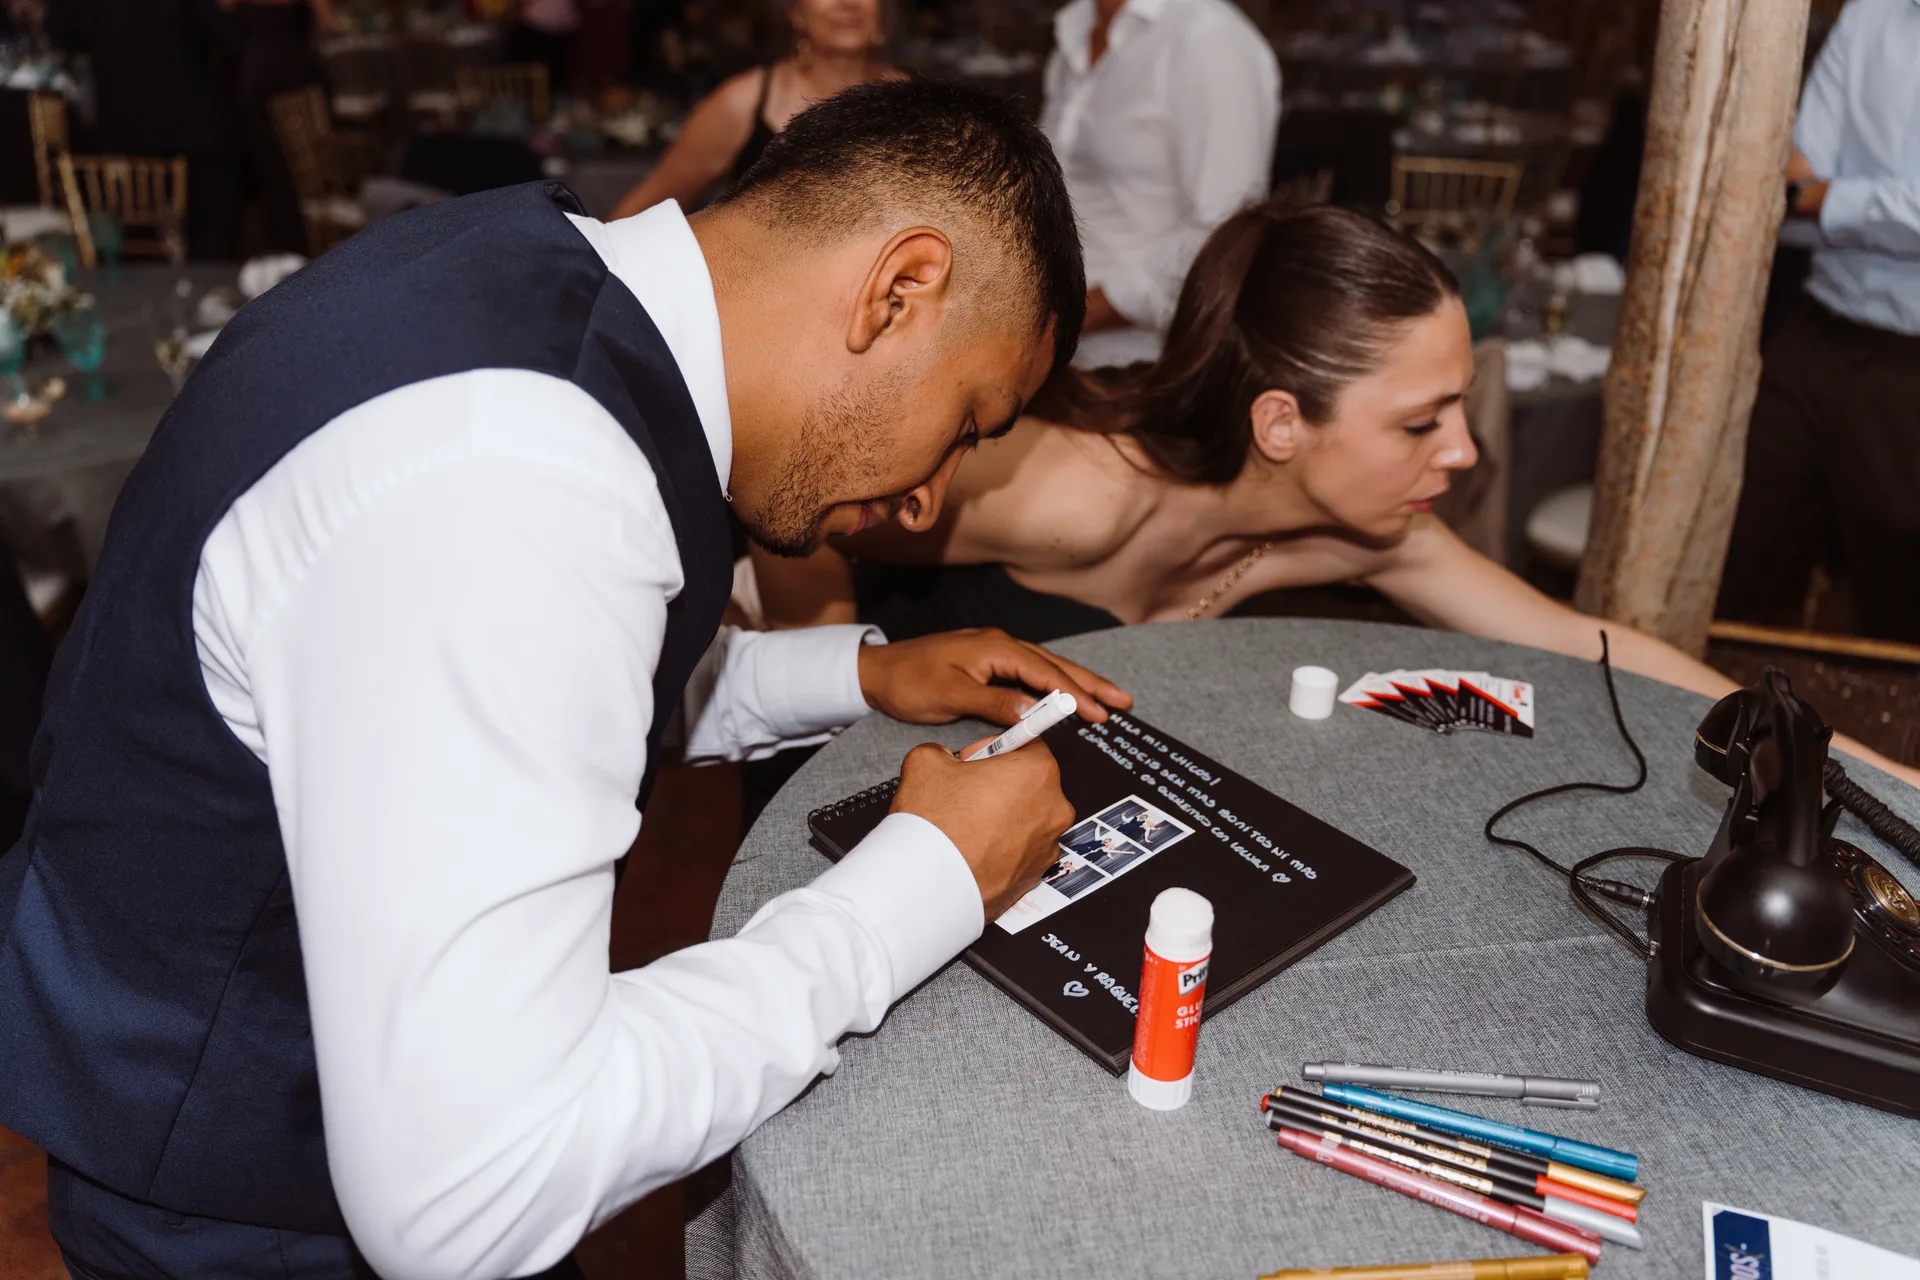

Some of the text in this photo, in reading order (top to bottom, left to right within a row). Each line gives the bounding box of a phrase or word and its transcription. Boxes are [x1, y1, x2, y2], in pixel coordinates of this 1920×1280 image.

[1159, 769, 1186, 787] SER
[1230, 842, 1270, 872] LOCURA
[1041, 933, 1081, 962] JEAN
[1084, 962, 1098, 973] Y
[1176, 1000, 1202, 1017] GLU
[1175, 1012, 1200, 1030] STIC
